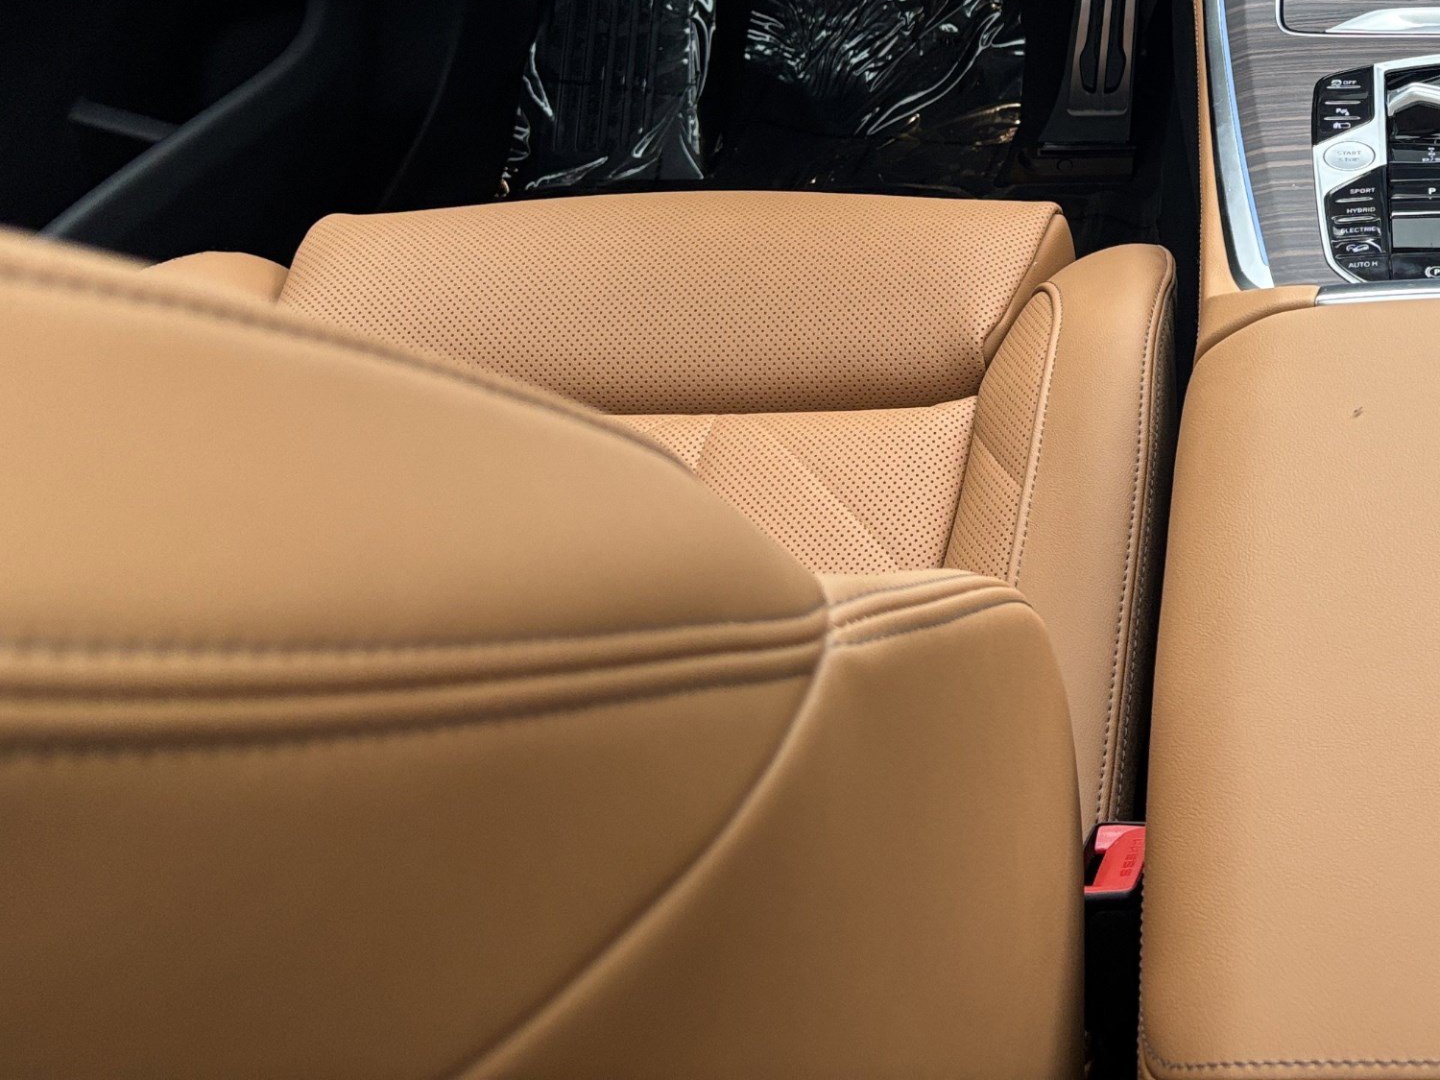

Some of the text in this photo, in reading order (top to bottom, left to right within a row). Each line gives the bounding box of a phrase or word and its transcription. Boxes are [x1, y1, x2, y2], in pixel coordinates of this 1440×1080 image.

[1350, 187, 1376, 195] SPORT
[1428, 187, 1436, 195] P
[1346, 206, 1376, 214] HYBRID
